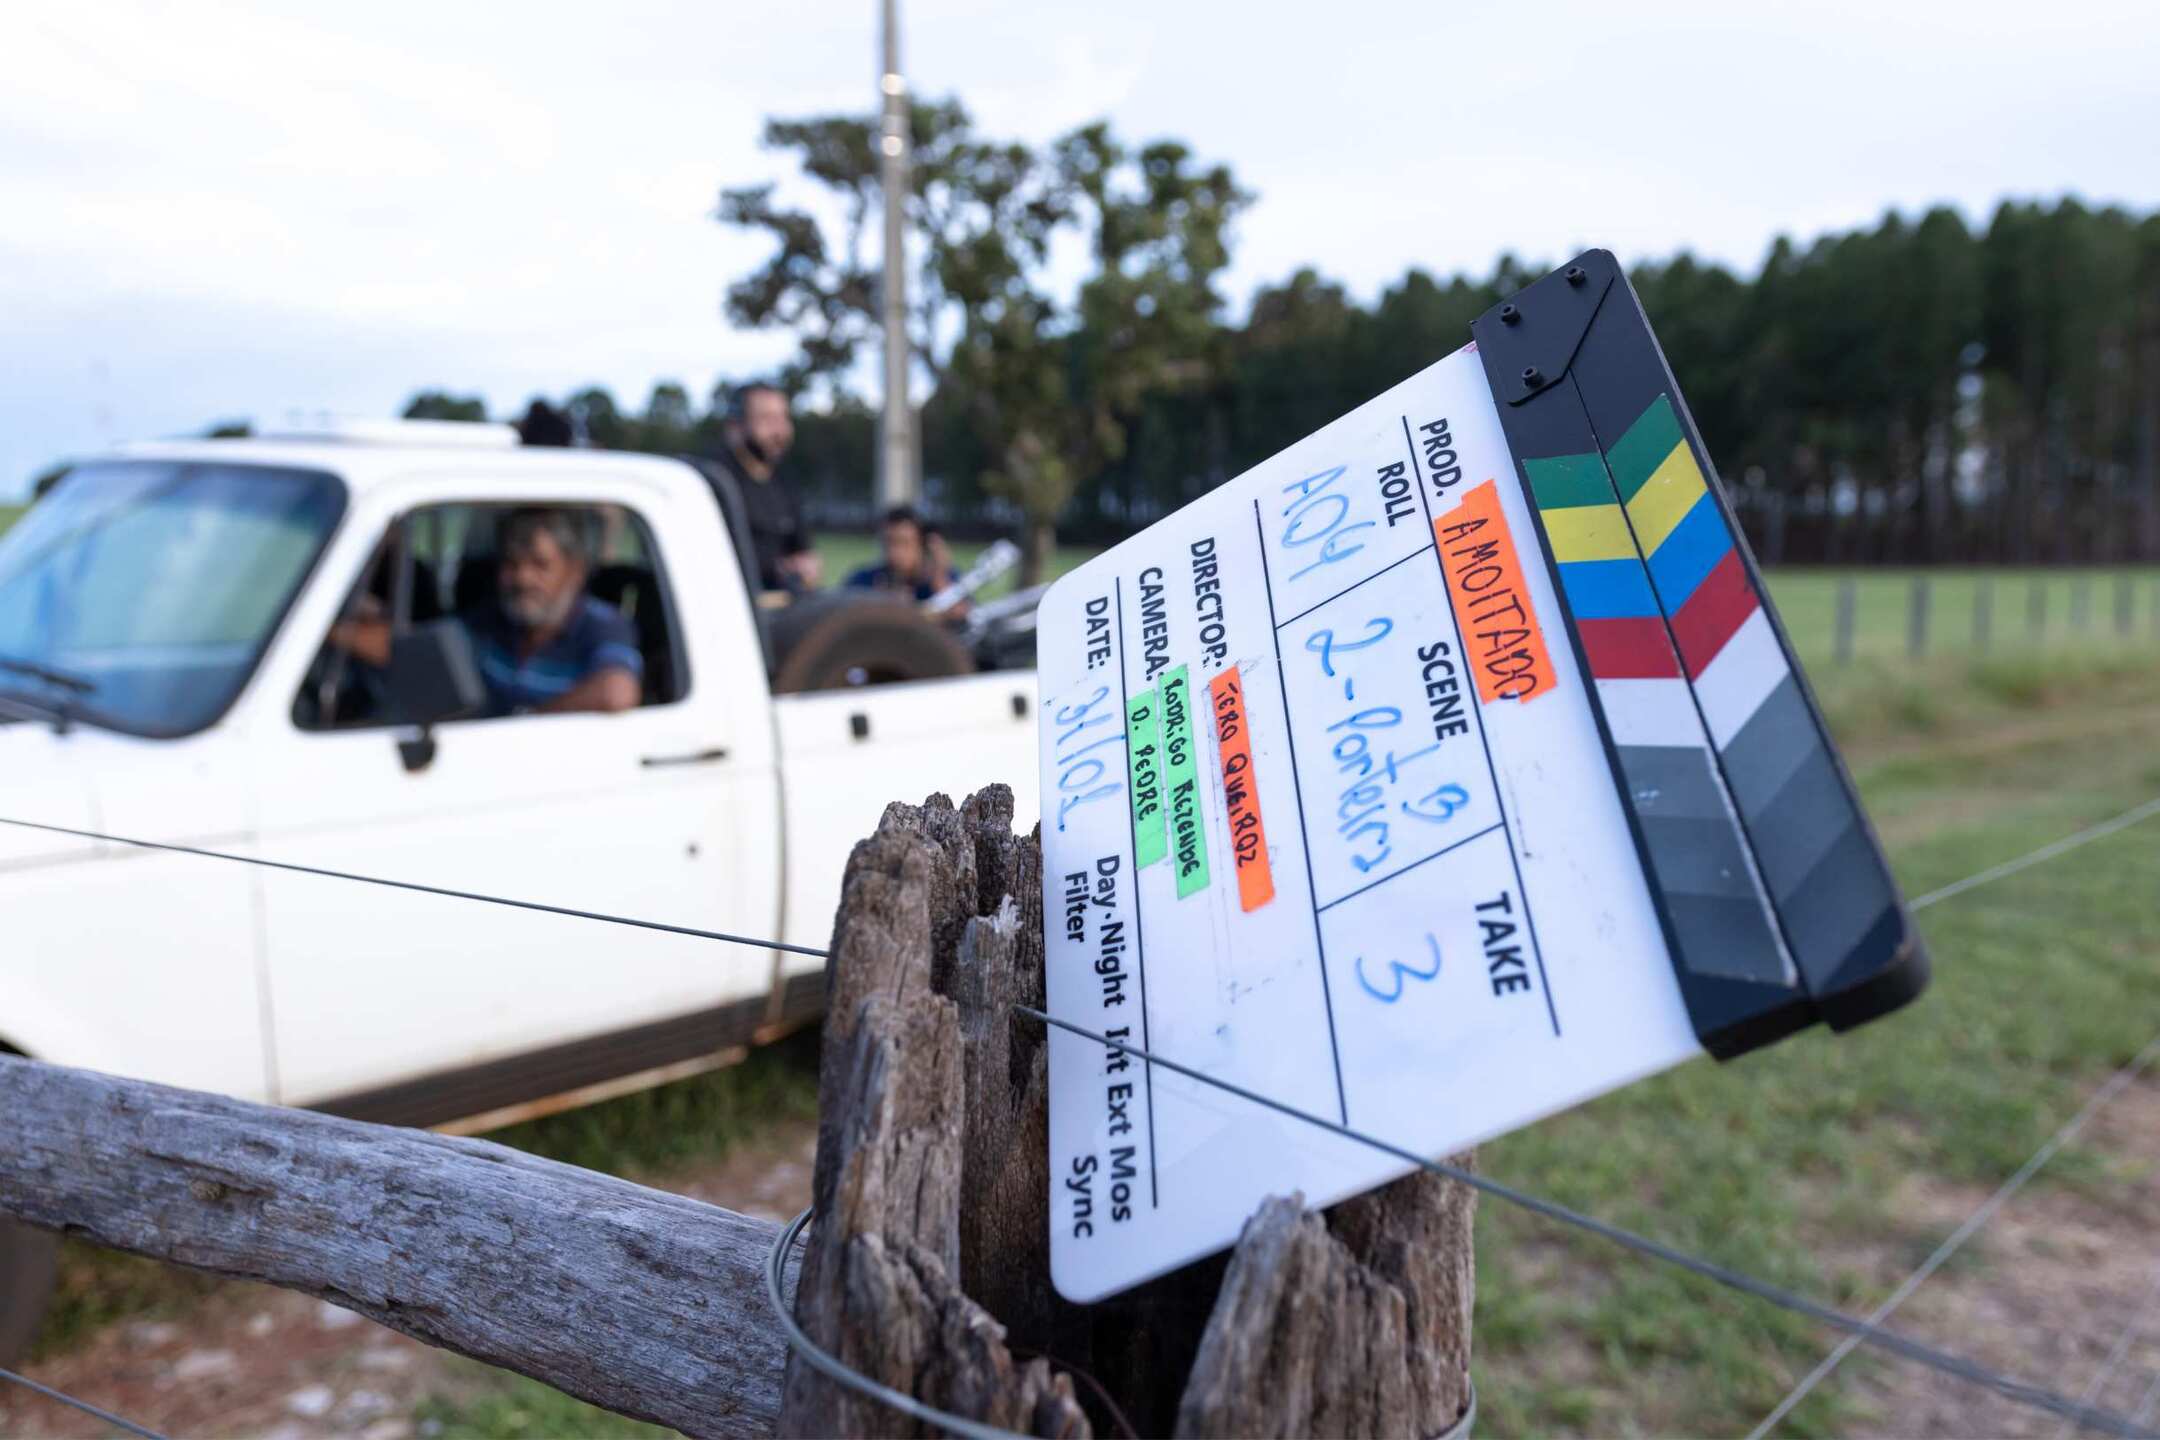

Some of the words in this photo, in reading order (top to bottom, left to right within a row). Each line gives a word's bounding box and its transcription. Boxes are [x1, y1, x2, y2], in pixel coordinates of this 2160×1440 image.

[1377, 461, 1415, 527] ROLL
[1420, 418, 1462, 498] PROD.
[1085, 596, 1111, 672] DATE:
[1139, 566, 1170, 682] CAMERA:
[1417, 641, 1469, 742] SCENE
[1064, 869, 1088, 944] Filter
[1475, 891, 1531, 997] TAKE
[1356, 932, 1442, 1004] 3
[1105, 1025, 1131, 1074] Int
[1107, 1080, 1132, 1136] Ext
[1064, 1155, 1098, 1239] Sync
[1109, 1145, 1137, 1223] Mos
